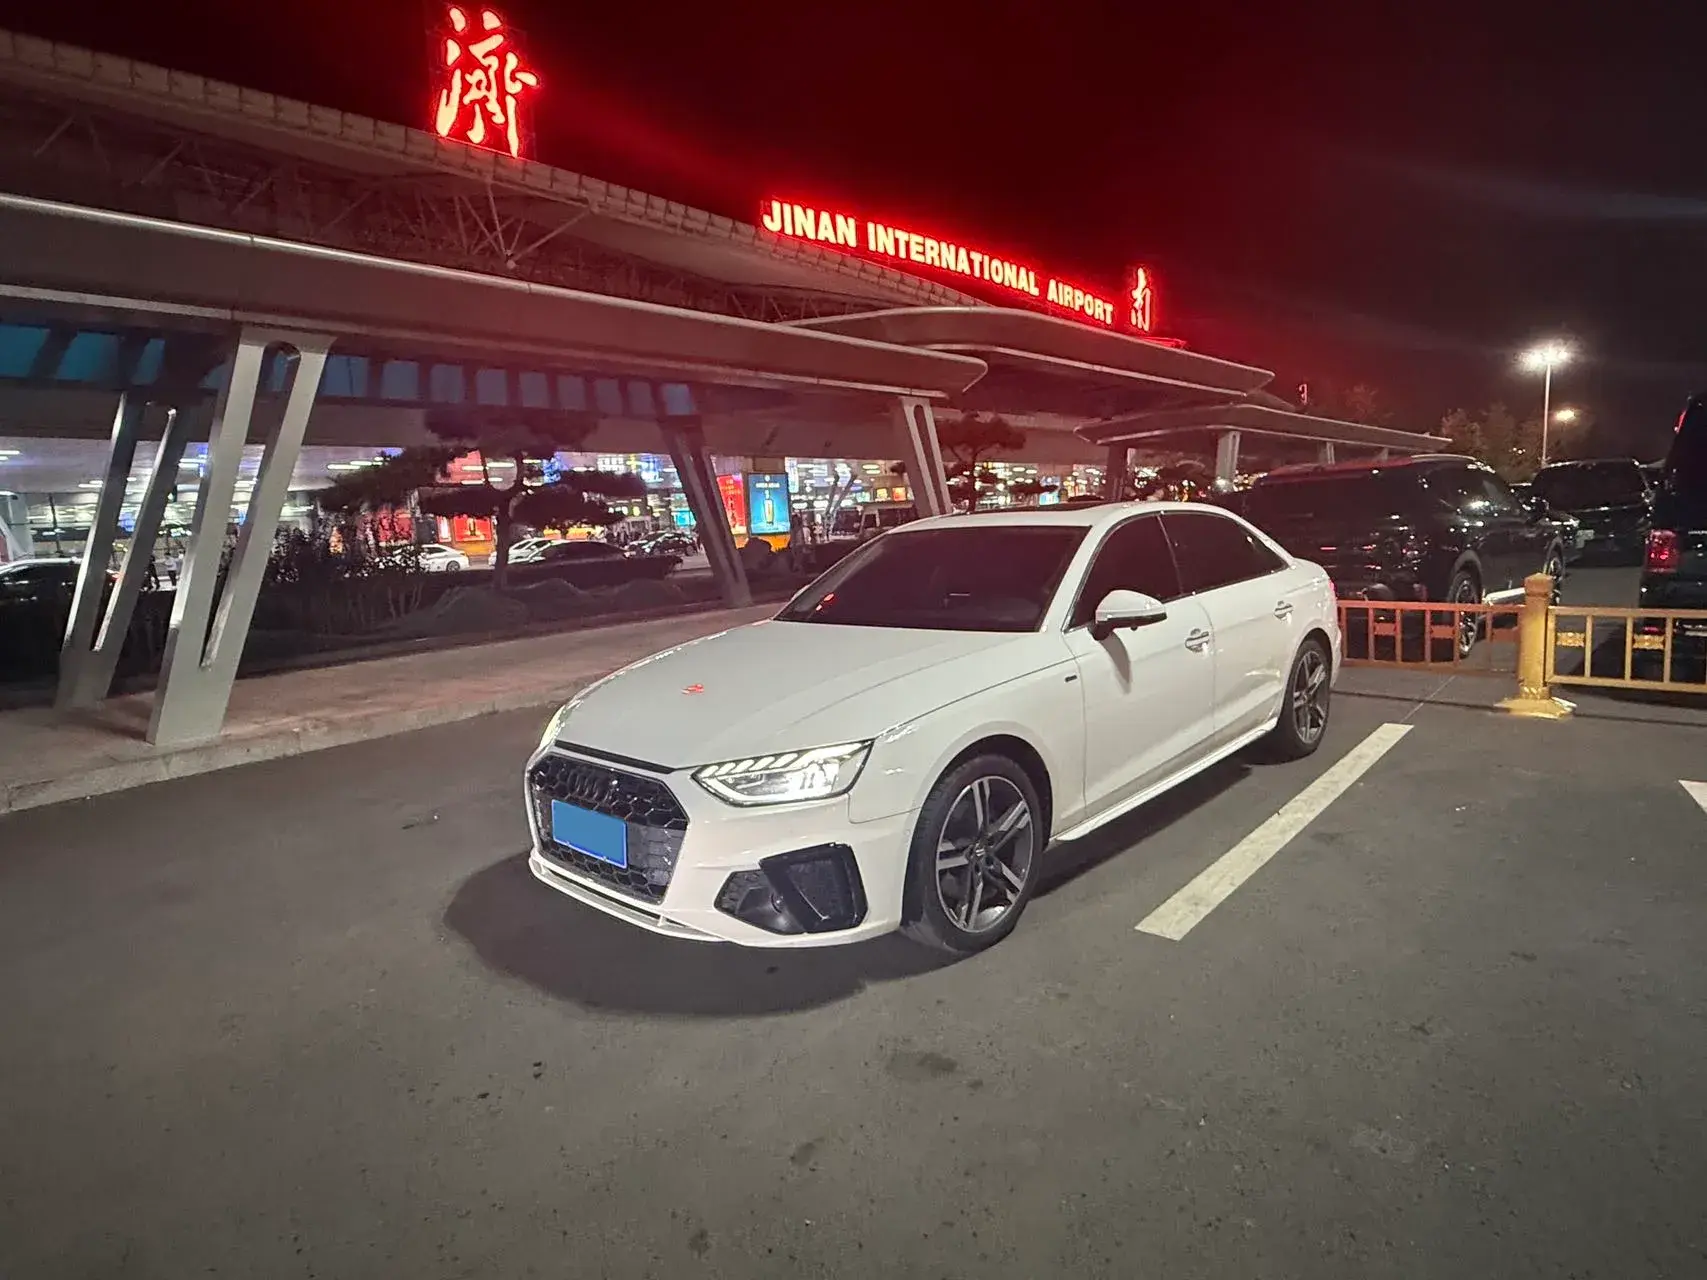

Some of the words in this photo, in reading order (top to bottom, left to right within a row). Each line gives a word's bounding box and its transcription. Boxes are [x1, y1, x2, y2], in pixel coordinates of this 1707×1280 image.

[761, 199, 858, 248] JINAN
[866, 221, 1041, 298] INTERNATIONAL
[1046, 278, 1114, 325] AIRPORT
